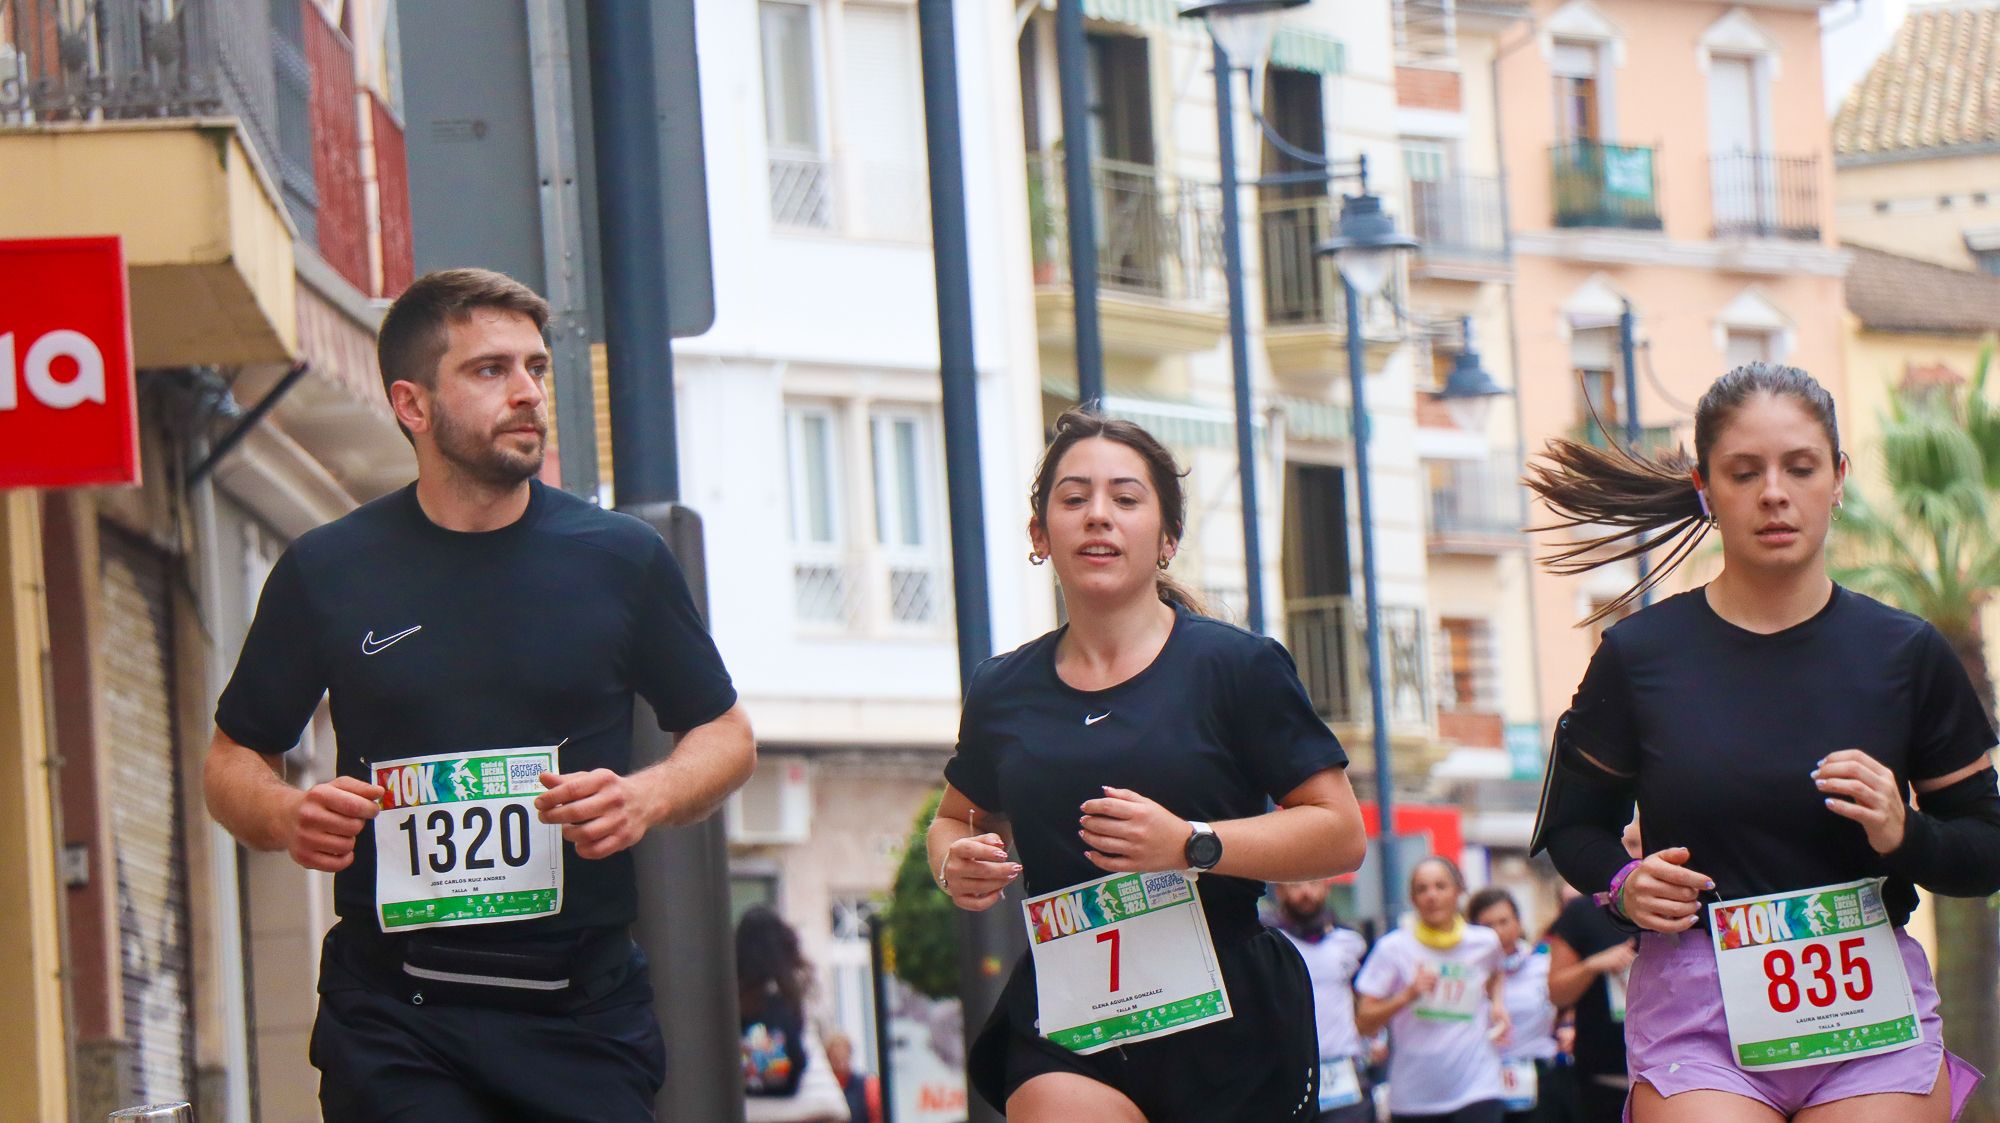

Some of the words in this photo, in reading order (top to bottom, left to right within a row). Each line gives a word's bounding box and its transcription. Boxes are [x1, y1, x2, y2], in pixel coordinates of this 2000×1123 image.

[481, 767, 505, 776] LUCENA
[510, 763, 542, 771] carreras
[387, 764, 438, 807] 10K
[483, 782, 507, 795] 2026
[400, 803, 531, 876] 1320
[1145, 873, 1176, 886] carreras
[1146, 876, 1185, 894] populares
[1119, 884, 1141, 897] LUCENA
[1123, 899, 1147, 915] 2026
[1834, 899, 1858, 910] LUCENA
[1042, 892, 1092, 938] 10K
[1838, 914, 1862, 929] 2026
[1730, 901, 1793, 946] 10K
[1096, 928, 1120, 992] 7
[1763, 937, 1873, 1013] 835
[1092, 1002, 1109, 1010] ELENA
[1110, 996, 1133, 1005] AGUILAR
[1116, 1005, 1131, 1013] TALLA
[1839, 1008, 1864, 1017] VINAGRE
